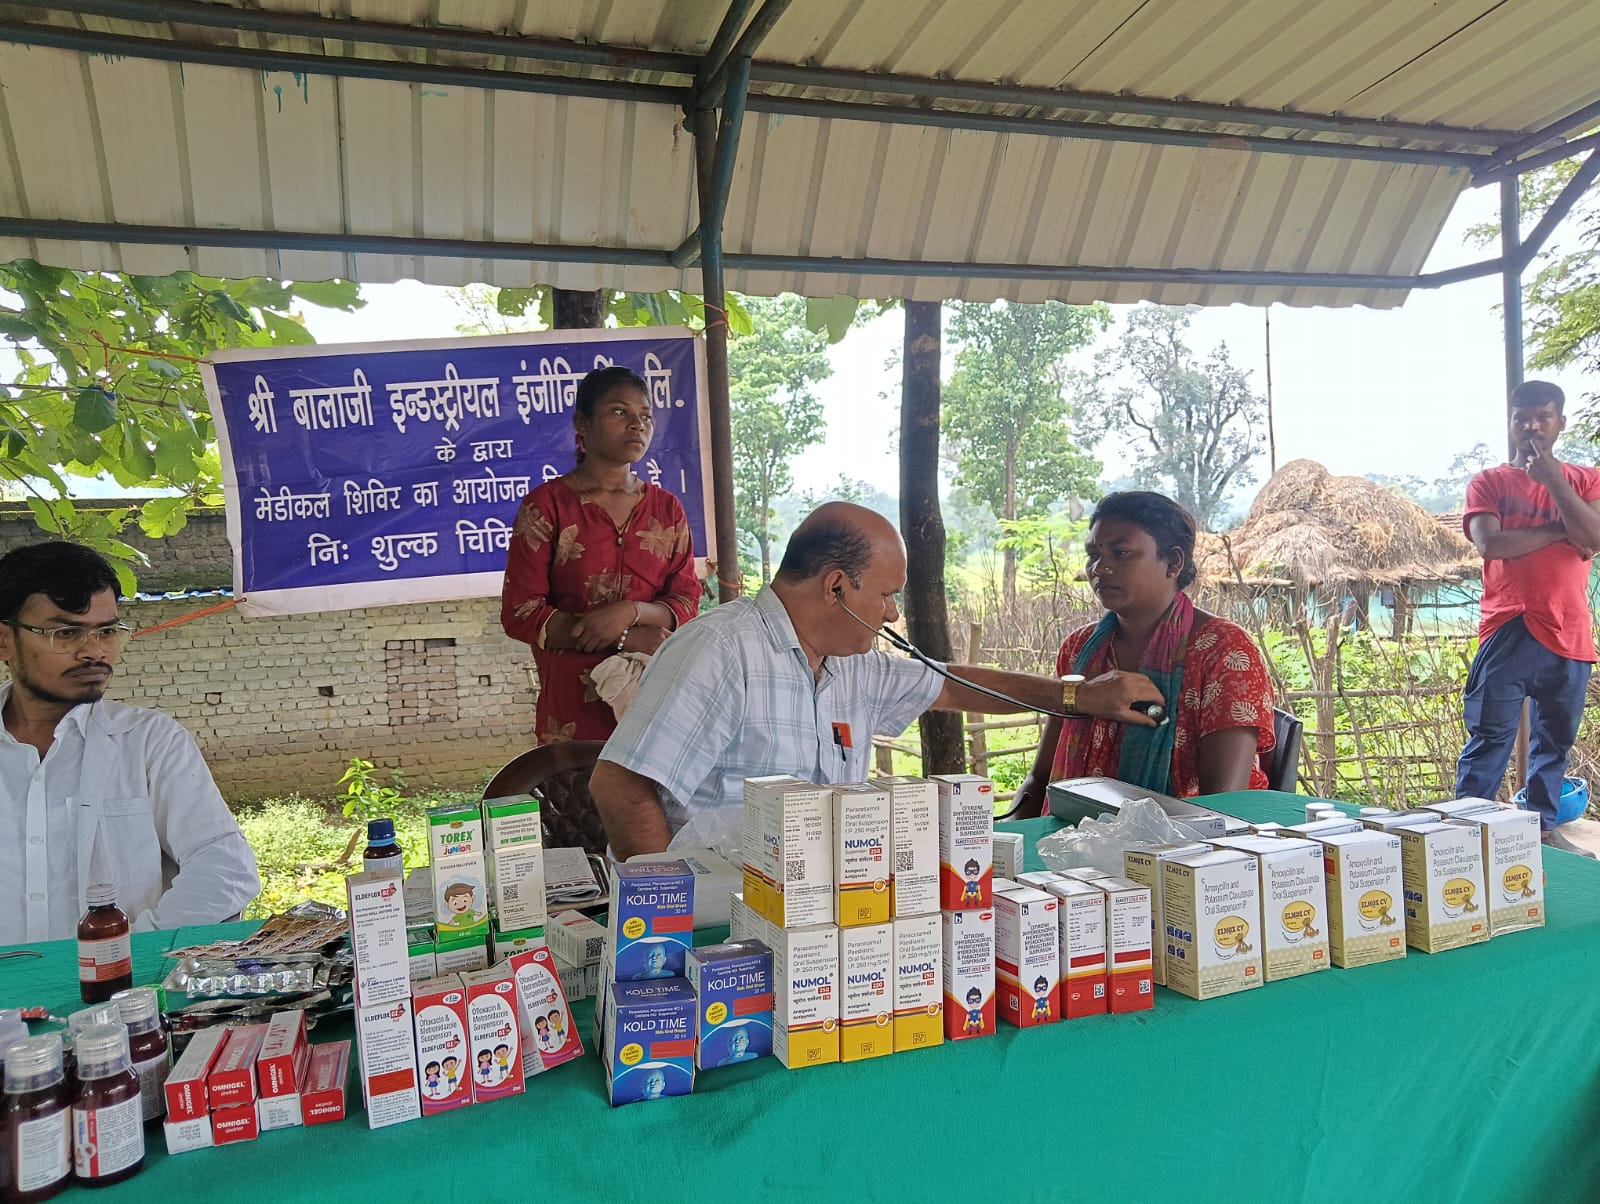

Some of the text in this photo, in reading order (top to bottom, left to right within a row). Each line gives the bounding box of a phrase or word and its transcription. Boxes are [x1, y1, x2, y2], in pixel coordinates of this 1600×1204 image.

[248, 375, 277, 434] श्री
[289, 368, 374, 431] बालाजी
[435, 437, 513, 464] के द्वारा
[255, 485, 330, 522] मेडीकल
[344, 479, 402, 516] शिविर
[412, 481, 439, 507] का
[453, 467, 531, 506] आयोजन
[371, 531, 438, 571] शुल्क
[845, 805, 880, 813] Paracetamol
[845, 812, 873, 820] Paediatric
[857, 818, 888, 827] Suspension
[440, 831, 473, 844] TOREX
[1516, 832, 1524, 840] and
[845, 838, 881, 849] NUMOL
[1455, 845, 1464, 853] and
[1495, 845, 1515, 855] Potassium
[1128, 856, 1144, 864] ELMOX
[1373, 856, 1382, 865] and
[1433, 858, 1454, 867] Potassium
[1495, 856, 1504, 865] Oral
[1504, 853, 1526, 864] Suspension
[1166, 865, 1182, 875] ELMOX
[1296, 866, 1305, 874] and
[1349, 869, 1372, 879] Potassium
[1434, 869, 1442, 877] Oral
[1443, 866, 1468, 876] Suspension
[1230, 880, 1239, 889] and
[1272, 880, 1295, 889] Potassium
[1350, 881, 1359, 889] Oral
[1360, 878, 1385, 888] Suspension
[626, 892, 687, 906] KOLD TIME
[1205, 893, 1228, 904] Potassium
[1272, 890, 1282, 900] Oral
[1282, 888, 1308, 898] Suspension
[1205, 905, 1215, 916] Oral
[1216, 903, 1241, 914] Suspension
[1361, 900, 1379, 908] ELMOX
[1284, 911, 1303, 920] ELMOX
[899, 930, 932, 939] Paracetamol
[1217, 926, 1236, 935] ELMOX
[793, 943, 829, 952] Paracetamol
[847, 939, 882, 948] Paracetamol
[899, 938, 926, 946] Paediatric
[911, 943, 941, 952] Suspension
[793, 951, 822, 960] Paediatric
[847, 947, 875, 956] Paediatric
[860, 952, 891, 961] Suspension
[793, 956, 838, 967] Oral Suspension
[899, 963, 934, 975] NUMOL
[708, 971, 765, 991] KOLD TIME
[792, 978, 831, 989] NUMOL
[847, 973, 884, 984] NUMOL
[625, 984, 681, 995] KOLD TIME
[473, 1020, 504, 1031] Suspension
[623, 1017, 687, 1032] KOLD TIME
[420, 1031, 452, 1043] Suspension
[269, 1063, 278, 1094] OMNIGEL
[212, 1080, 245, 1092] OMNIGEL
[183, 1084, 194, 1115] OMNIGEL
[216, 1118, 250, 1129] OMNIGEL
